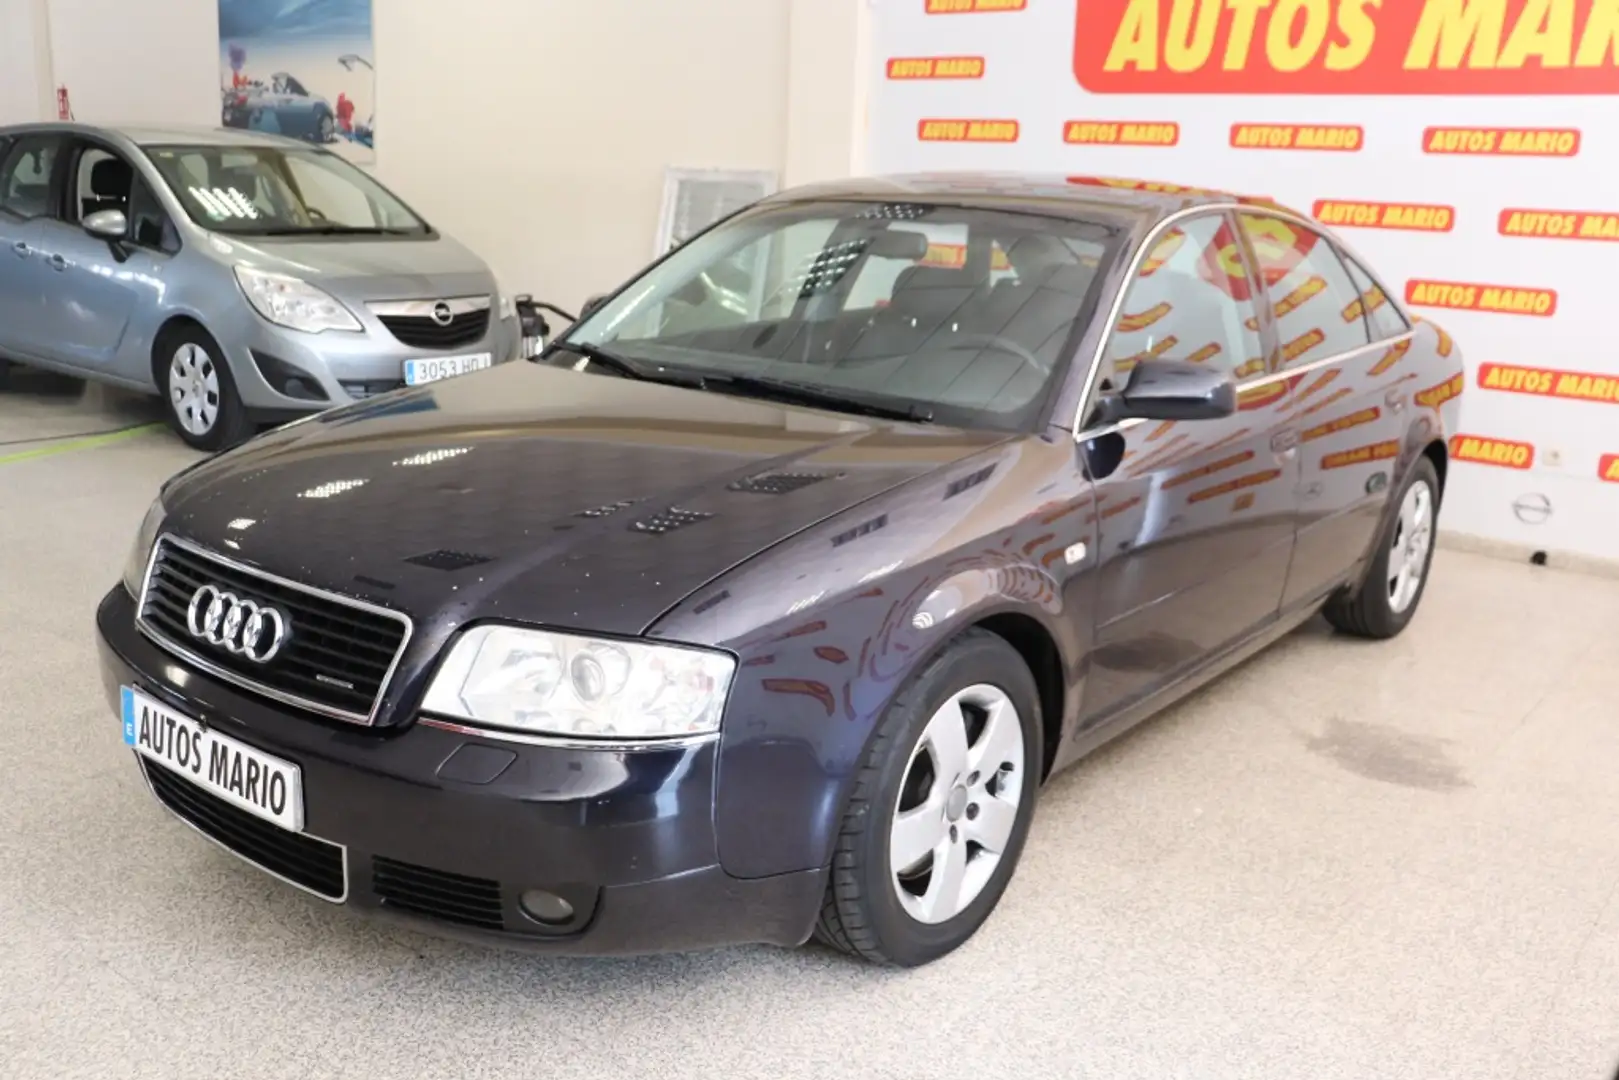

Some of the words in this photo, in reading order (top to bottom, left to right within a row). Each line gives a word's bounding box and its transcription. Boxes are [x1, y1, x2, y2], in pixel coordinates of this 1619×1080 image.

[1102, 0, 1383, 72] AUTOS
[890, 60, 931, 77] AUTOS
[935, 59, 982, 77] MARIO
[922, 121, 965, 140] AUTOS
[966, 122, 1017, 141] MARIO
[1068, 123, 1118, 143] AUTOS
[1120, 124, 1175, 144] MARIO
[1235, 126, 1293, 147] AUTOS
[1294, 127, 1359, 149] MARIO
[1429, 130, 1496, 151] AUTOS
[1498, 131, 1575, 154] MARIO
[1318, 202, 1379, 225] AUTOS
[1381, 205, 1450, 229] MARIO
[1505, 211, 1577, 236] AUTOS
[1580, 215, 1619, 238] MA
[1410, 281, 1475, 307] AUTOS
[1478, 286, 1551, 314] MARIO
[419, 360, 458, 380] 3053
[1484, 366, 1554, 393] AUTOS
[1458, 438, 1529, 466] MARIO
[139, 706, 201, 774] AUTOS
[209, 740, 286, 815] MARIO
